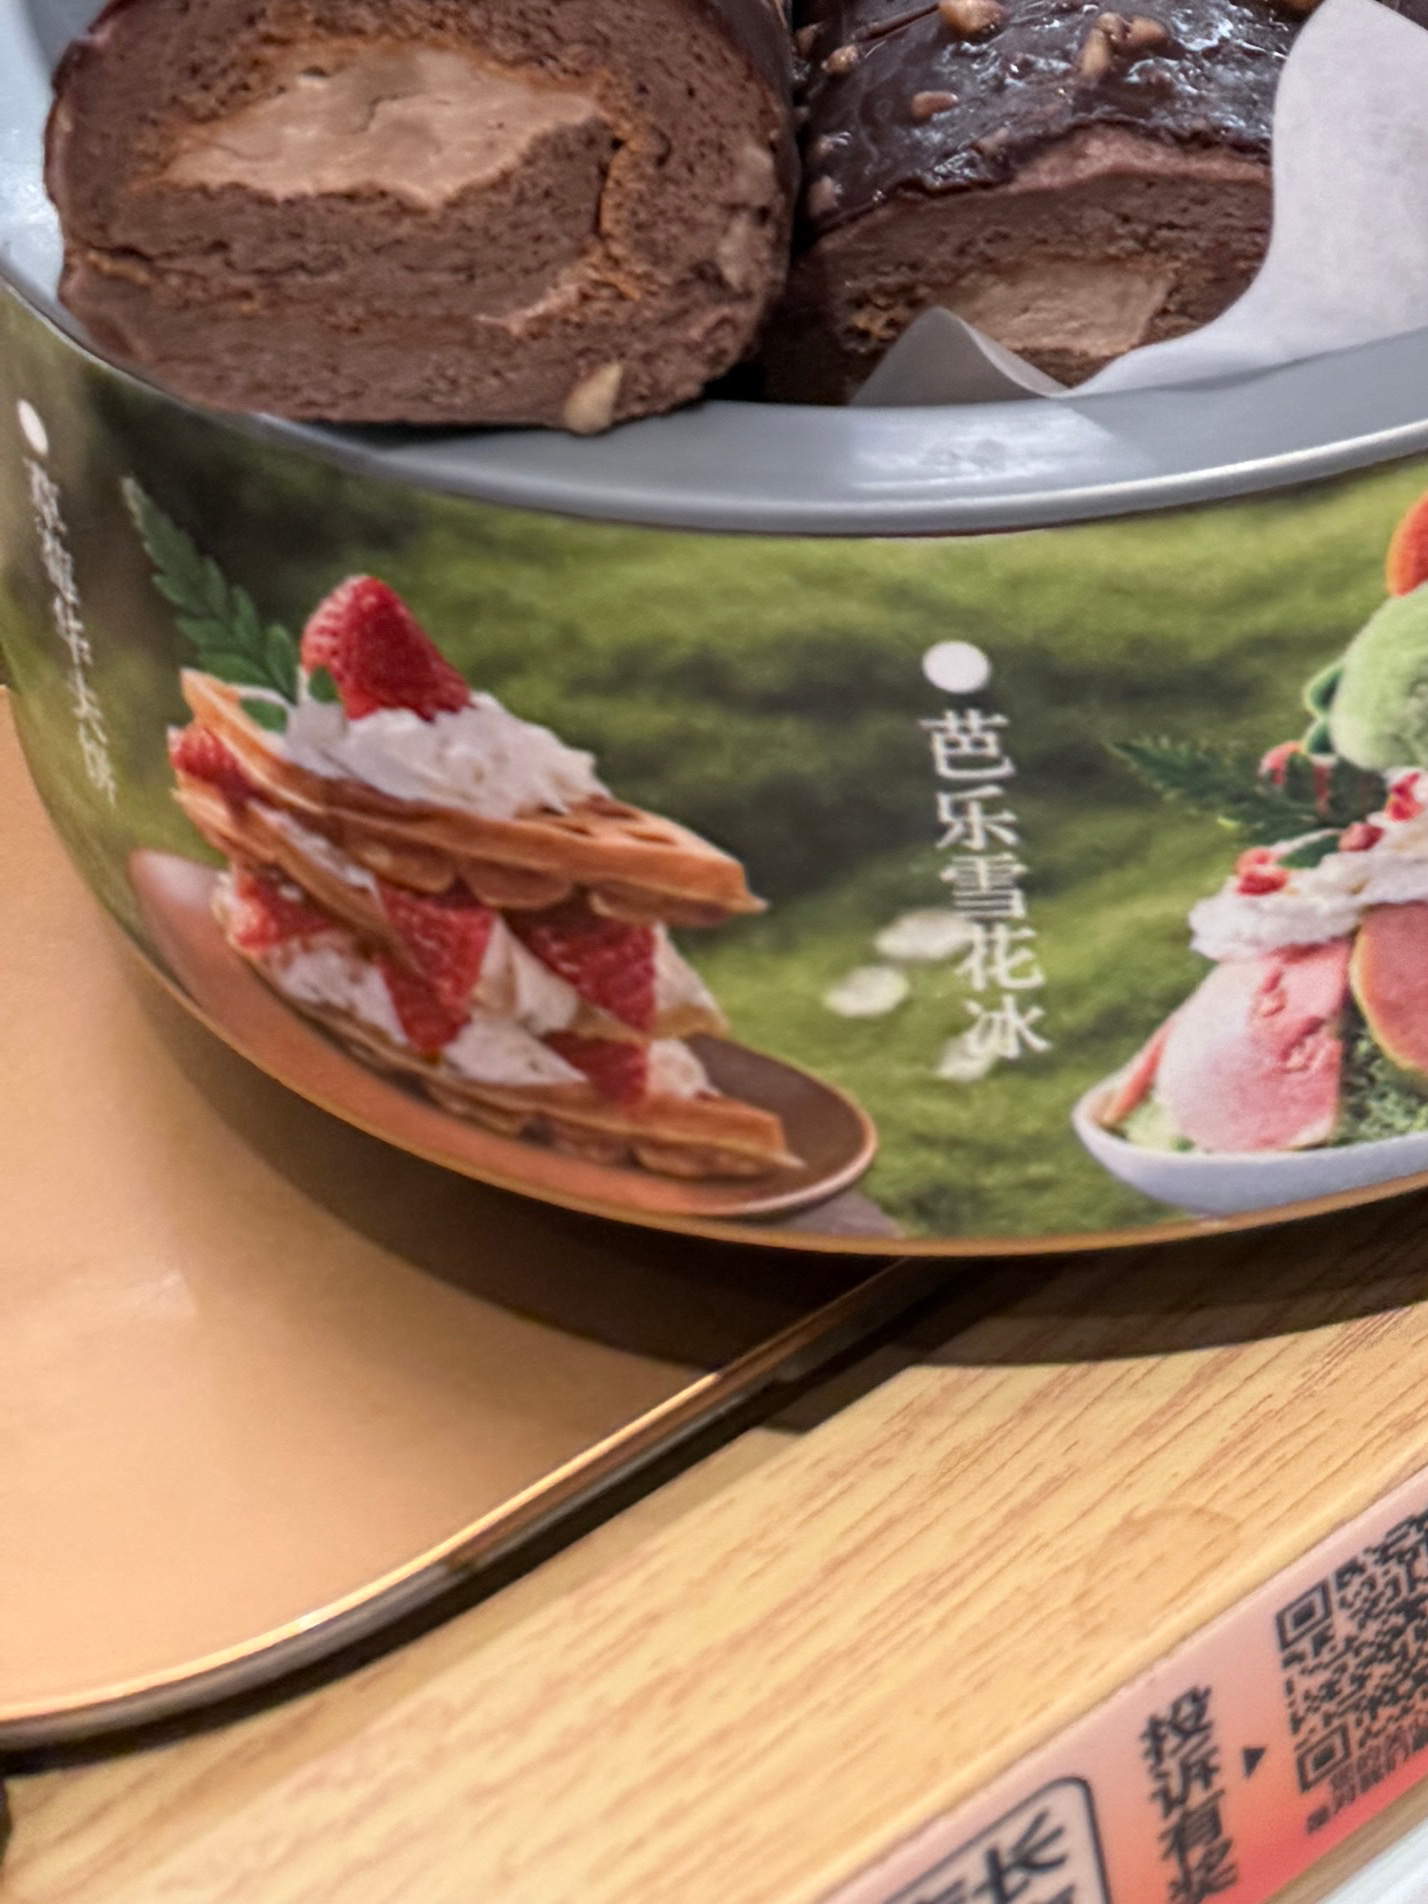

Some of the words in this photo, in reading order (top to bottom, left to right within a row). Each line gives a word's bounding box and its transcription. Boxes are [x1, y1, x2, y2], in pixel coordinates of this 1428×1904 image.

[918, 707, 1055, 1062] 芭乐雪花冰
